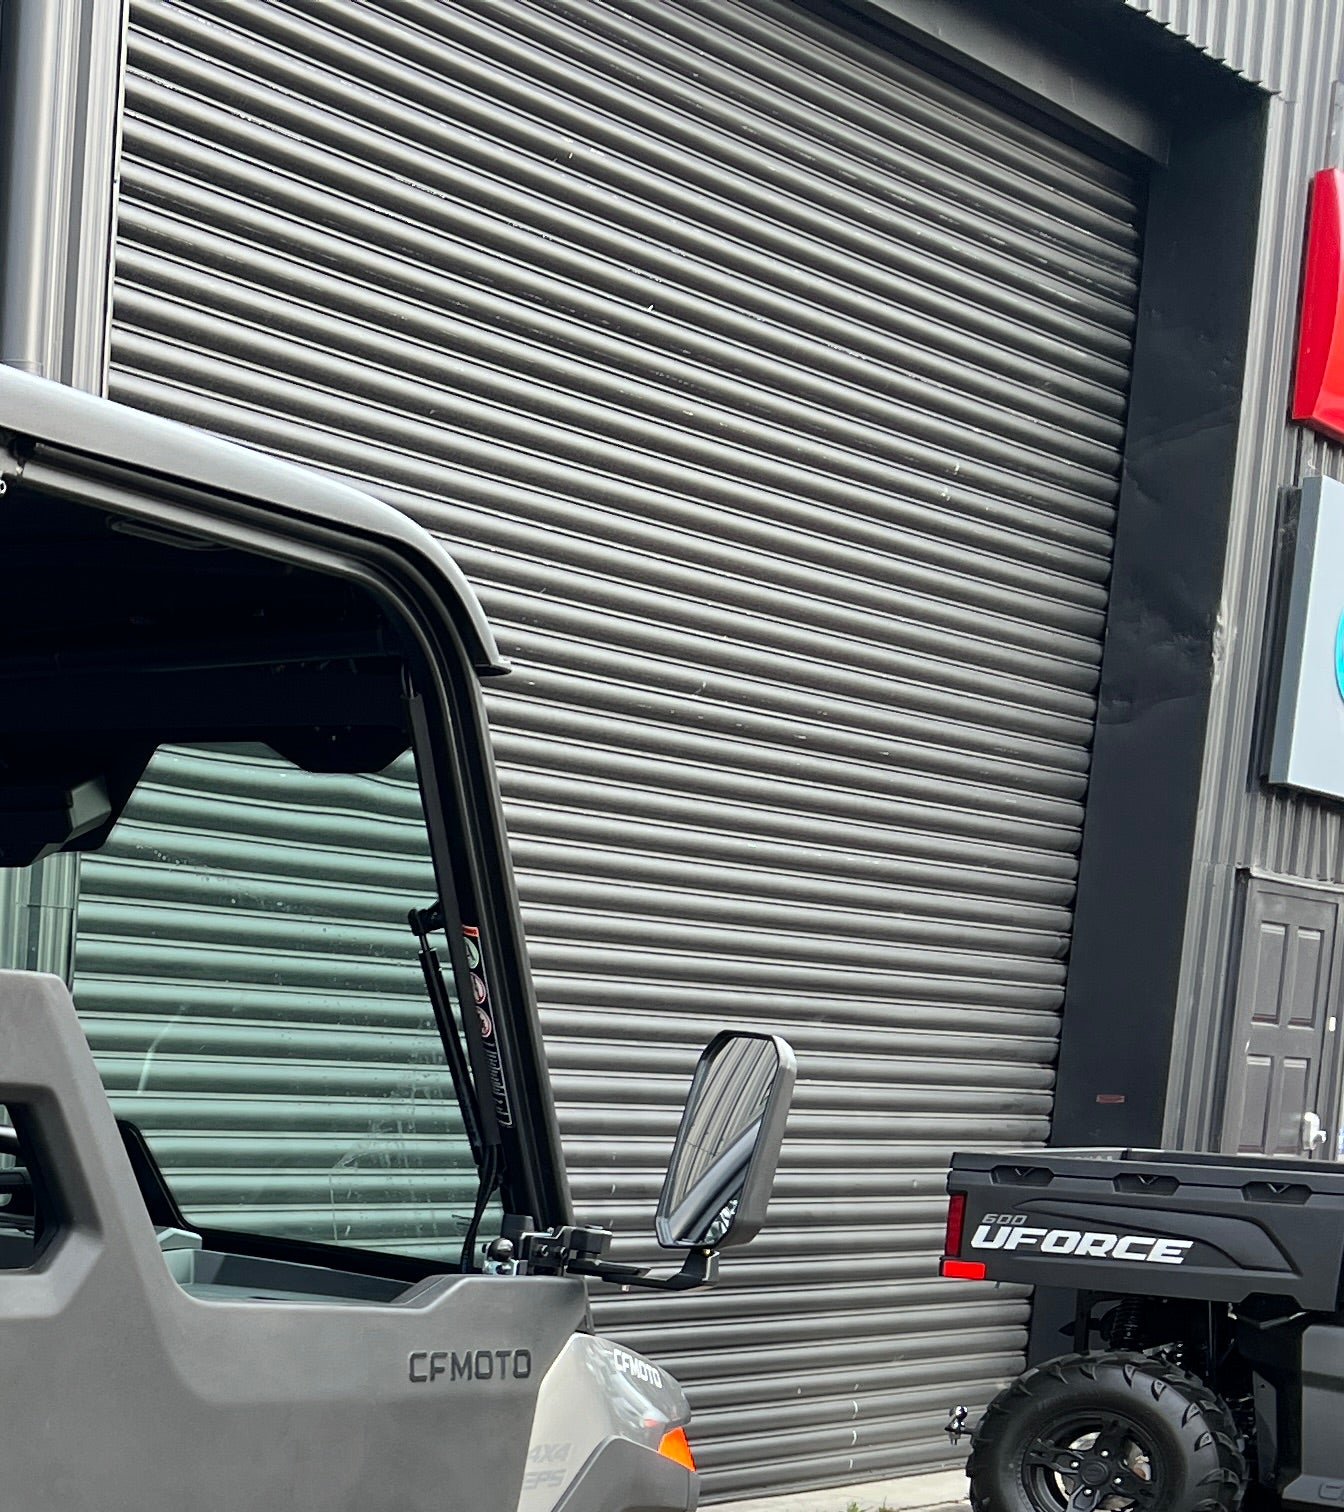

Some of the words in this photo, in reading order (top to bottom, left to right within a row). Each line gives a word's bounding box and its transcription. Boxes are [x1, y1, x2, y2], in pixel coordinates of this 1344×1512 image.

[982, 1213, 1027, 1226] 600
[971, 1225, 1194, 1264] UFORCE
[410, 1349, 531, 1382] CFMOTO
[613, 1348, 663, 1389] CFMOTO
